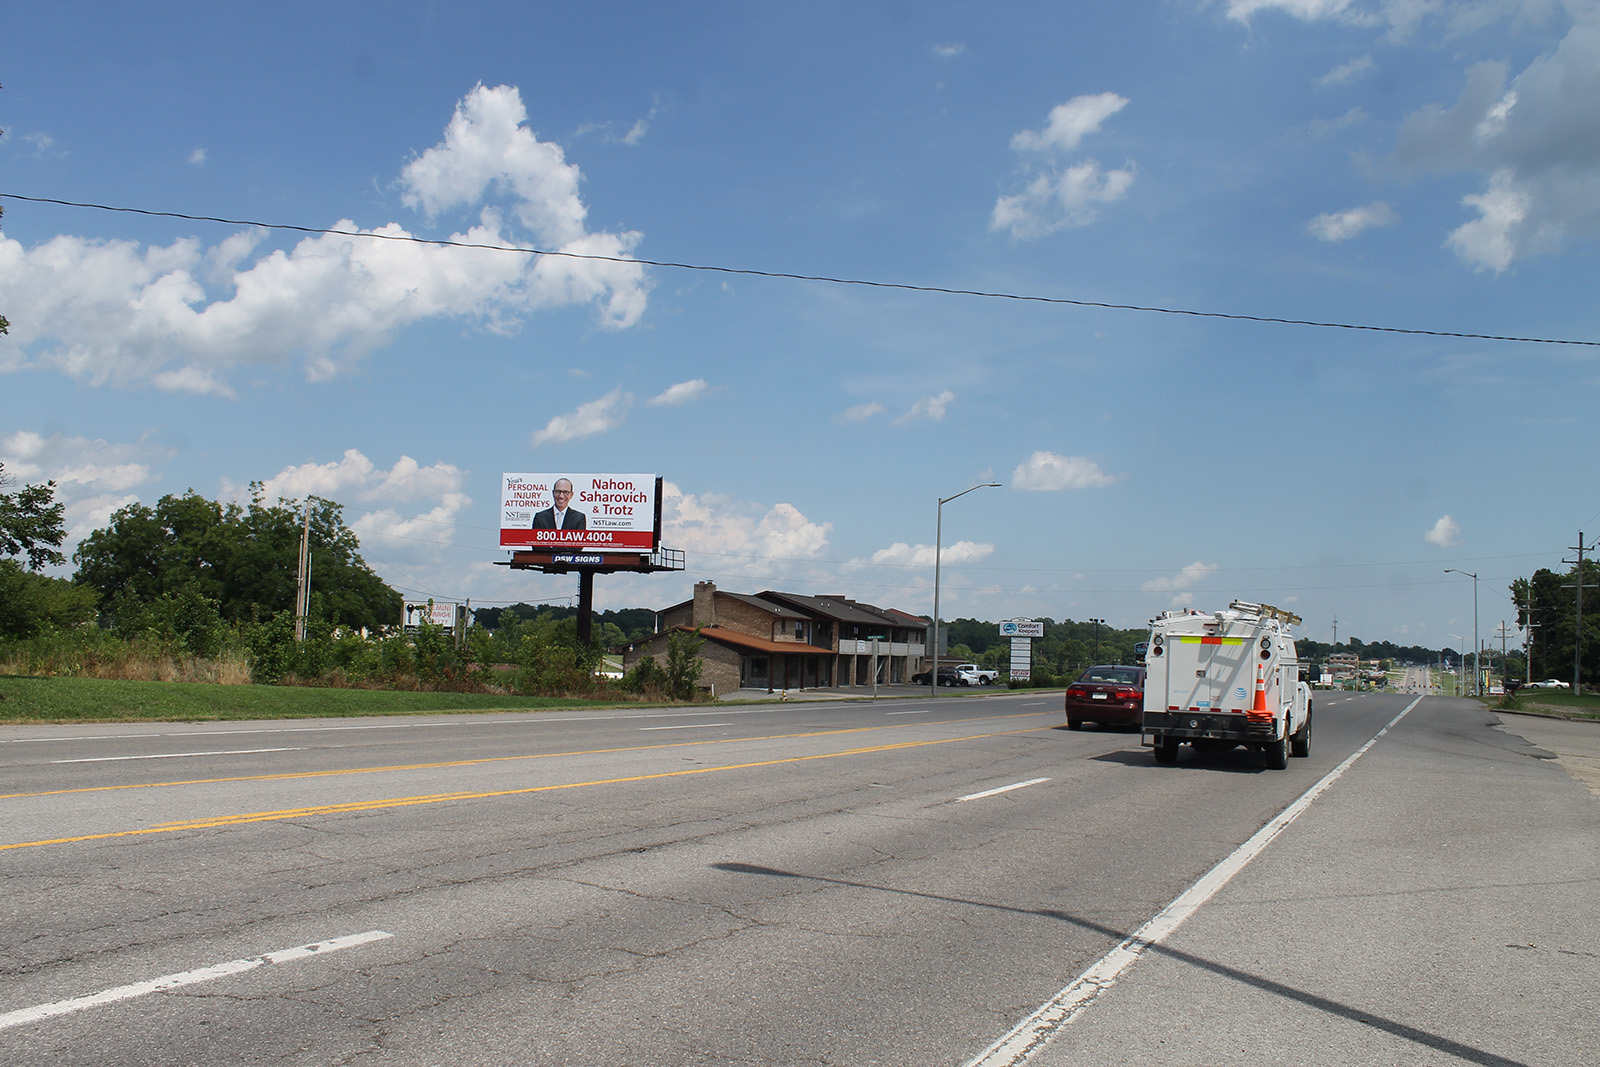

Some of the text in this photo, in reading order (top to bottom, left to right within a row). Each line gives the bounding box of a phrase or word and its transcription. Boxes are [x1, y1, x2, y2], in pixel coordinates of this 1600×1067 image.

[592, 478, 636, 492] Nahon,
[579, 491, 648, 503] Saharovich
[504, 500, 550, 508] ATTORNEYS
[592, 504, 634, 515] & Trotz
[536, 531, 614, 542] 800.LAW.4004
[574, 555, 601, 563] SIGNS
